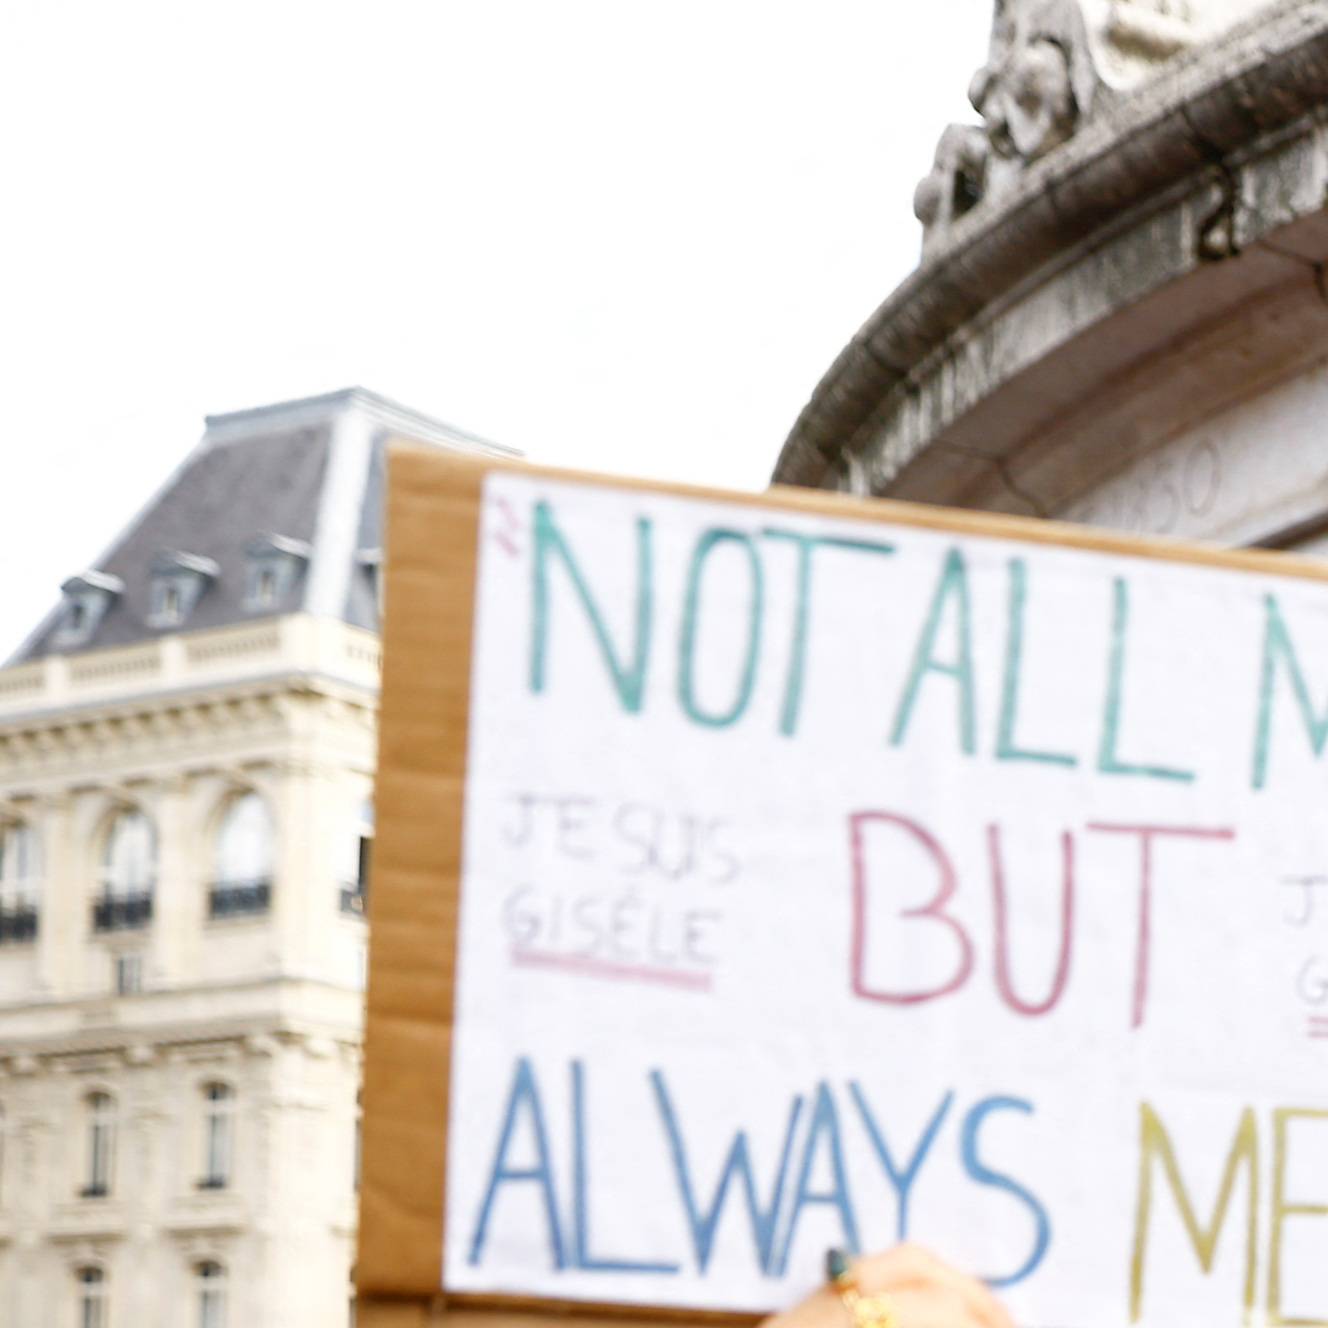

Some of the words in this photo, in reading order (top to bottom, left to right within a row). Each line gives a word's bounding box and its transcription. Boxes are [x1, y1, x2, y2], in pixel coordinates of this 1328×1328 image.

[527, 498, 897, 739] NOT
[889, 545, 1198, 783] ALL
[500, 790, 598, 862] JE
[847, 808, 1237, 1031] BUT
[467, 1056, 1052, 1288] ALWAYS
